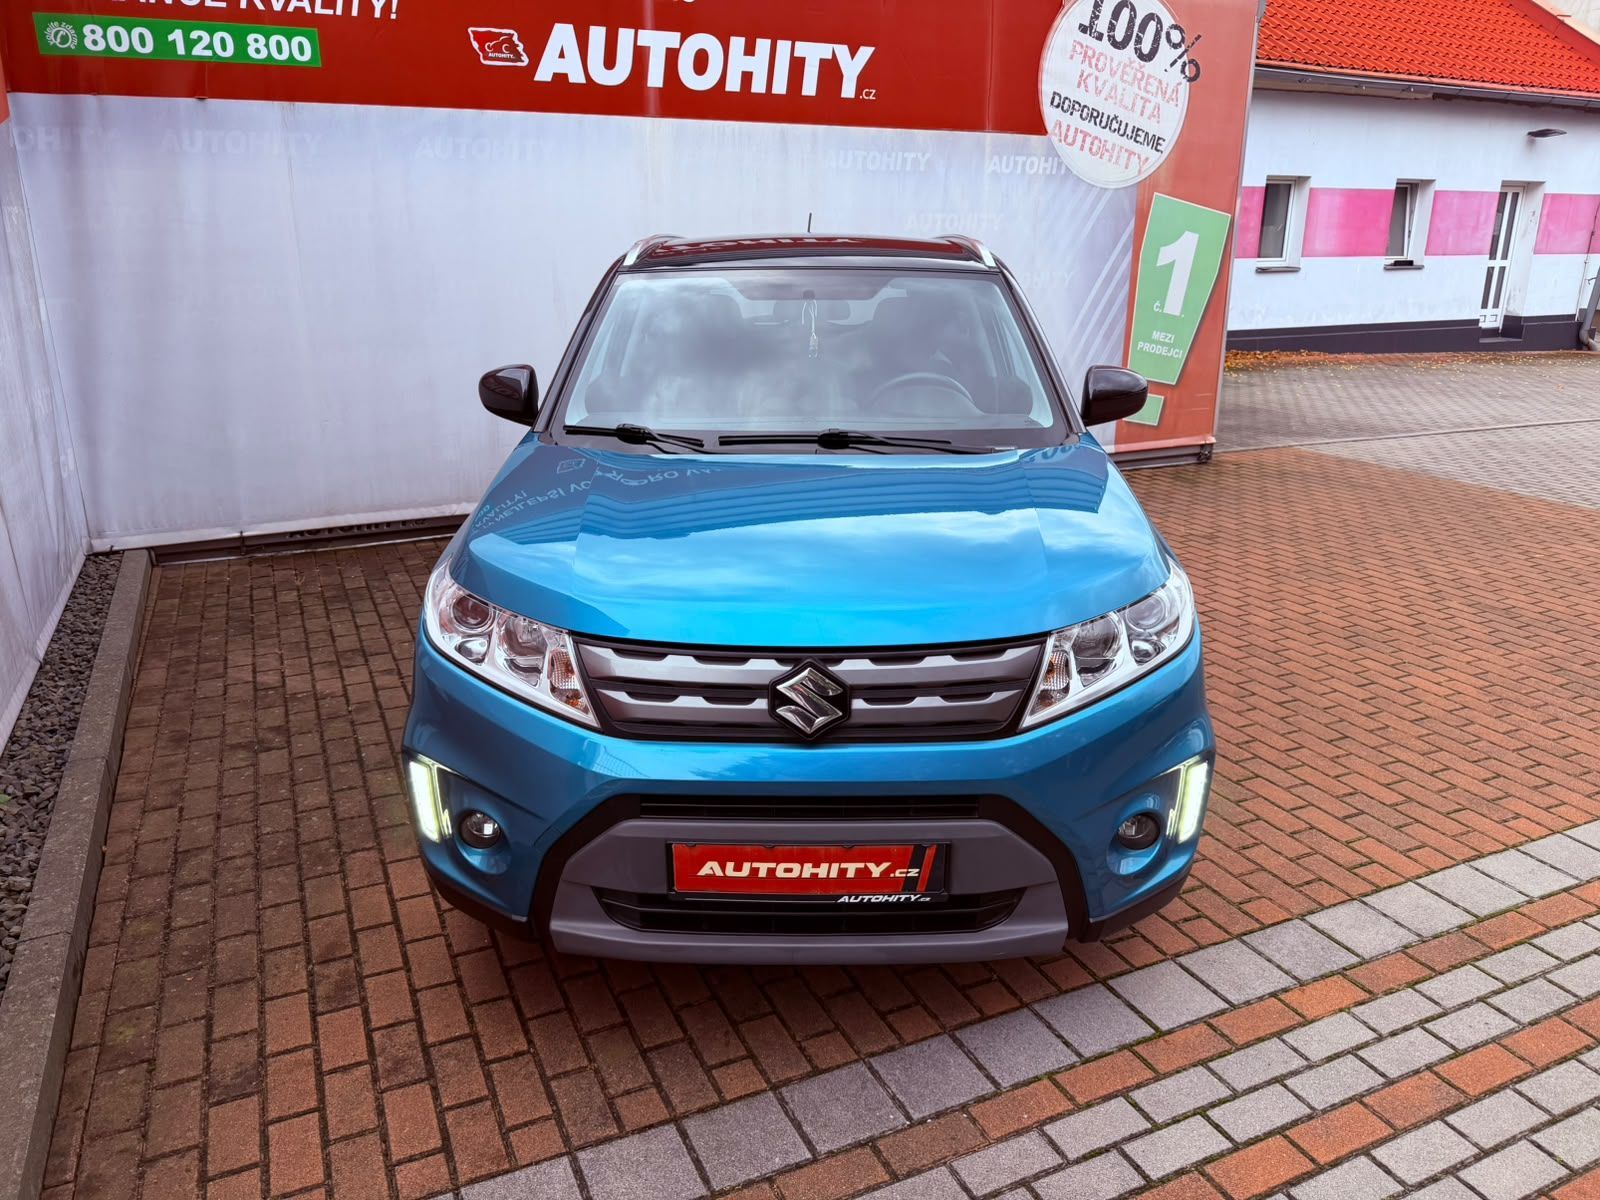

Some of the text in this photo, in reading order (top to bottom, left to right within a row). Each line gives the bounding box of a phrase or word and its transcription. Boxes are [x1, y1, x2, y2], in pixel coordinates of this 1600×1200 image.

[83, 24, 312, 62] 800 120 800
[1078, 0, 1202, 83] 100%
[1069, 39, 1182, 108] PROVĚŘENÁ
[1077, 70, 1162, 124] KVALITA
[1050, 91, 1166, 154] DOPORUČUJEME
[824, 151, 932, 172] AUTOHITY
[987, 155, 1068, 176] AUTOHIT
[1051, 119, 1150, 176] AUTOHITY
[1137, 341, 1183, 359] PRODEJCI
[1152, 330, 1175, 344] MEZI
